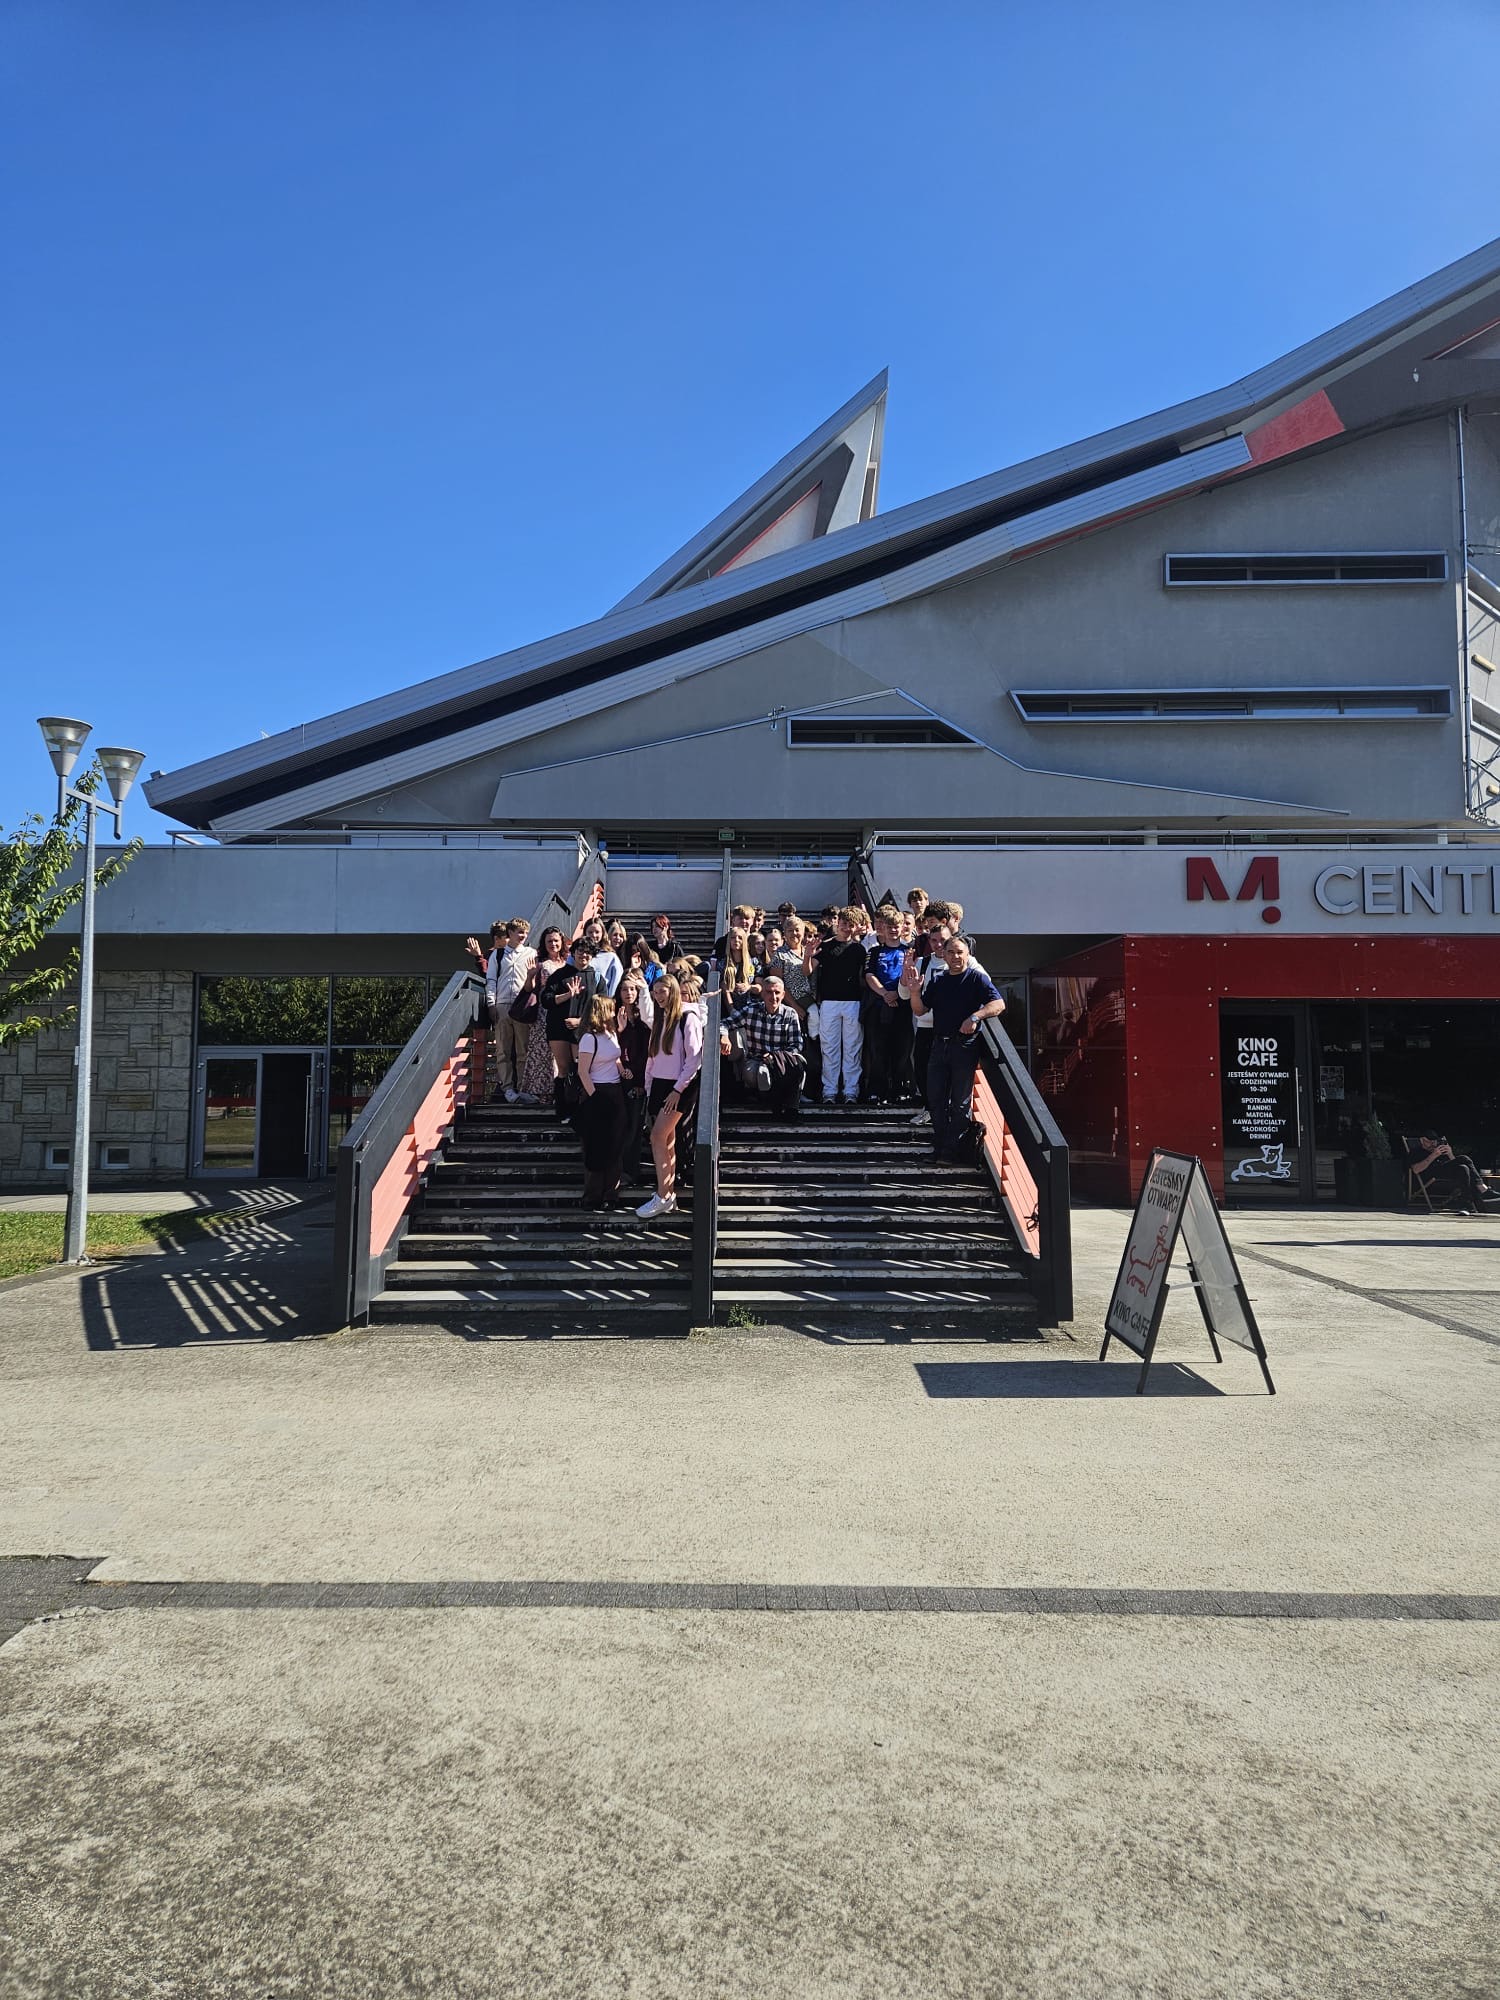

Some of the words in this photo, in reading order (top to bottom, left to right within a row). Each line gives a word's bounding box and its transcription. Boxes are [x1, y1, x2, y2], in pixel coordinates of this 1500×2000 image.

[1314, 864, 1500, 915] CENT
[1238, 1037, 1278, 1052] KINO
[1237, 1053, 1278, 1067] CAFE
[1227, 1070, 1259, 1078] JESTEŚMY
[1147, 1186, 1181, 1214] OTWARCI
[1113, 1299, 1131, 1324] KINO
[1130, 1311, 1150, 1338] CAFE
